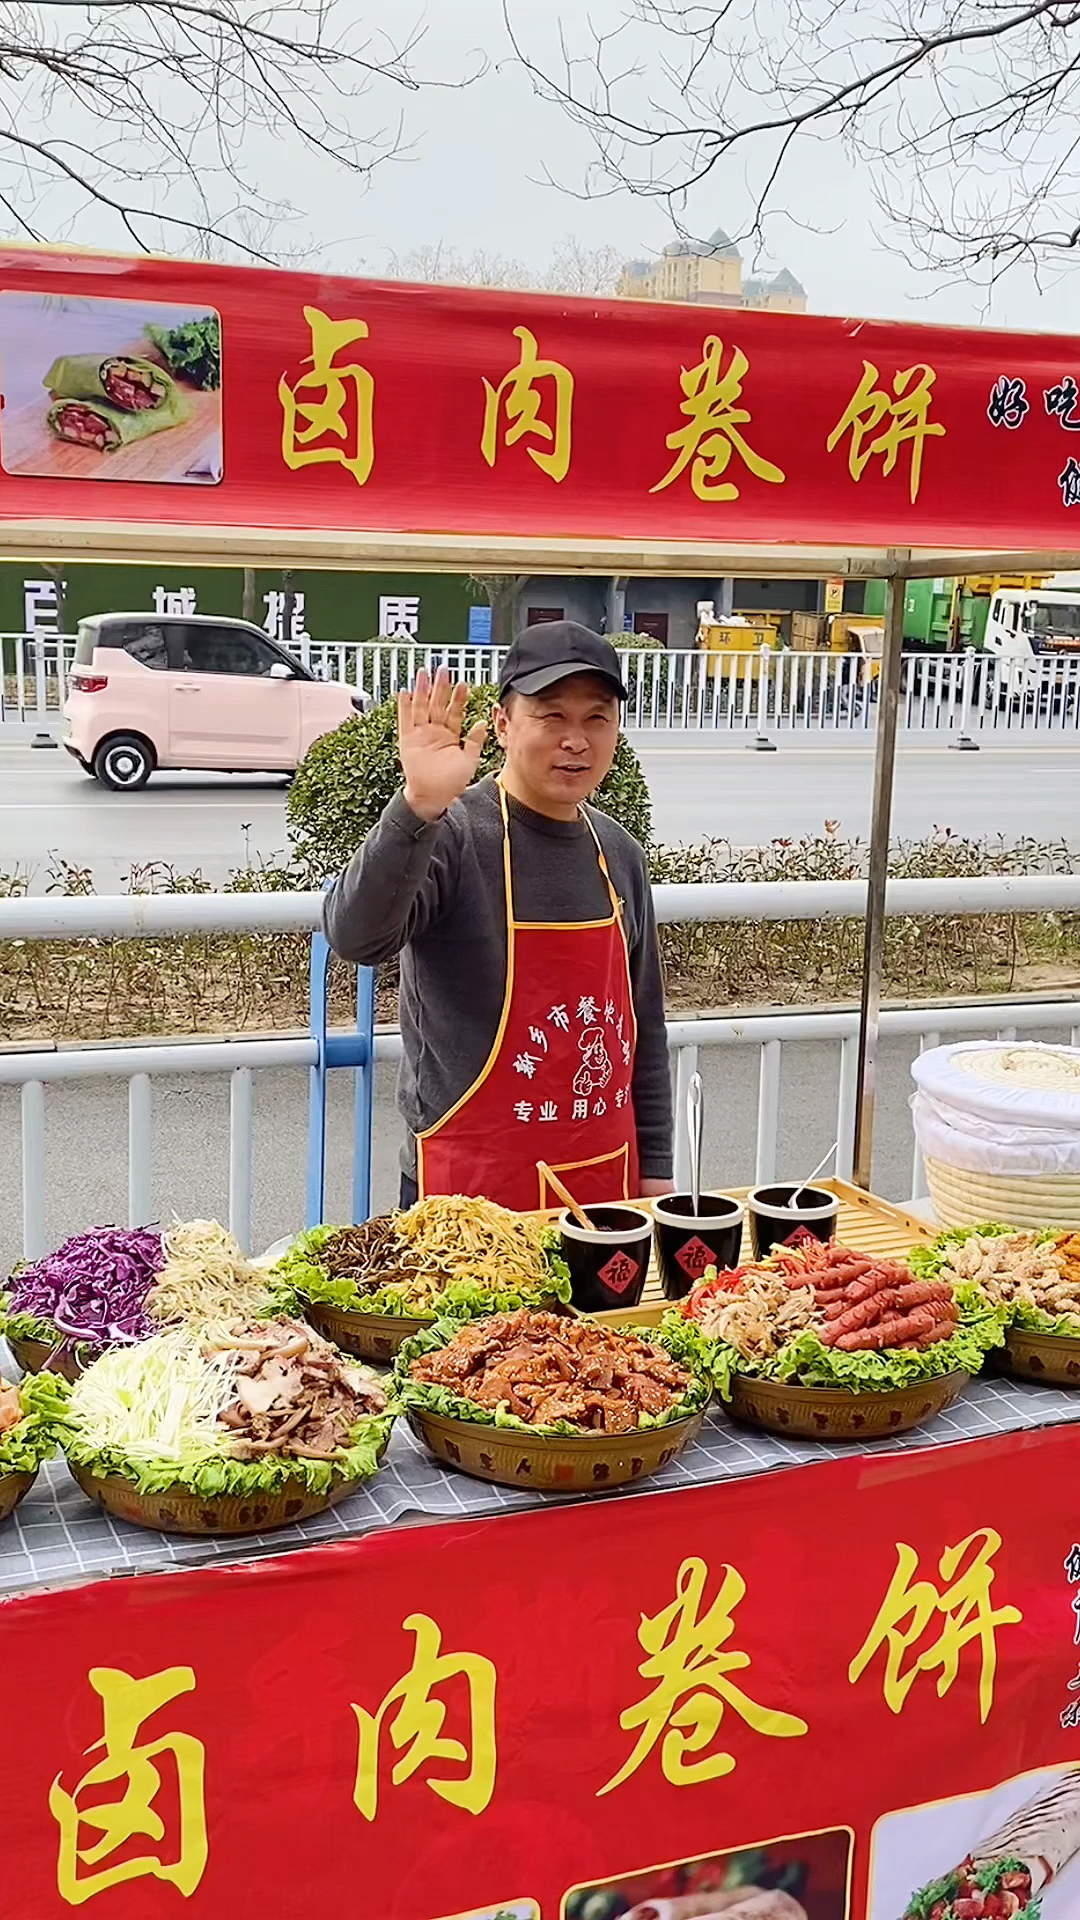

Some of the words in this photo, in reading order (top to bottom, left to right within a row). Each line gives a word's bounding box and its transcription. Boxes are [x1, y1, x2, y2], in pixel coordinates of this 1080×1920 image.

[278, 306, 946, 503] 卤肉卷饼
[512, 1100, 559, 1123] 专业
[571, 1097, 607, 1120] 用心
[682, 1245, 708, 1270] 福
[606, 1261, 631, 1285] 福
[47, 1529, 1022, 1906] 卤肉卷饼
